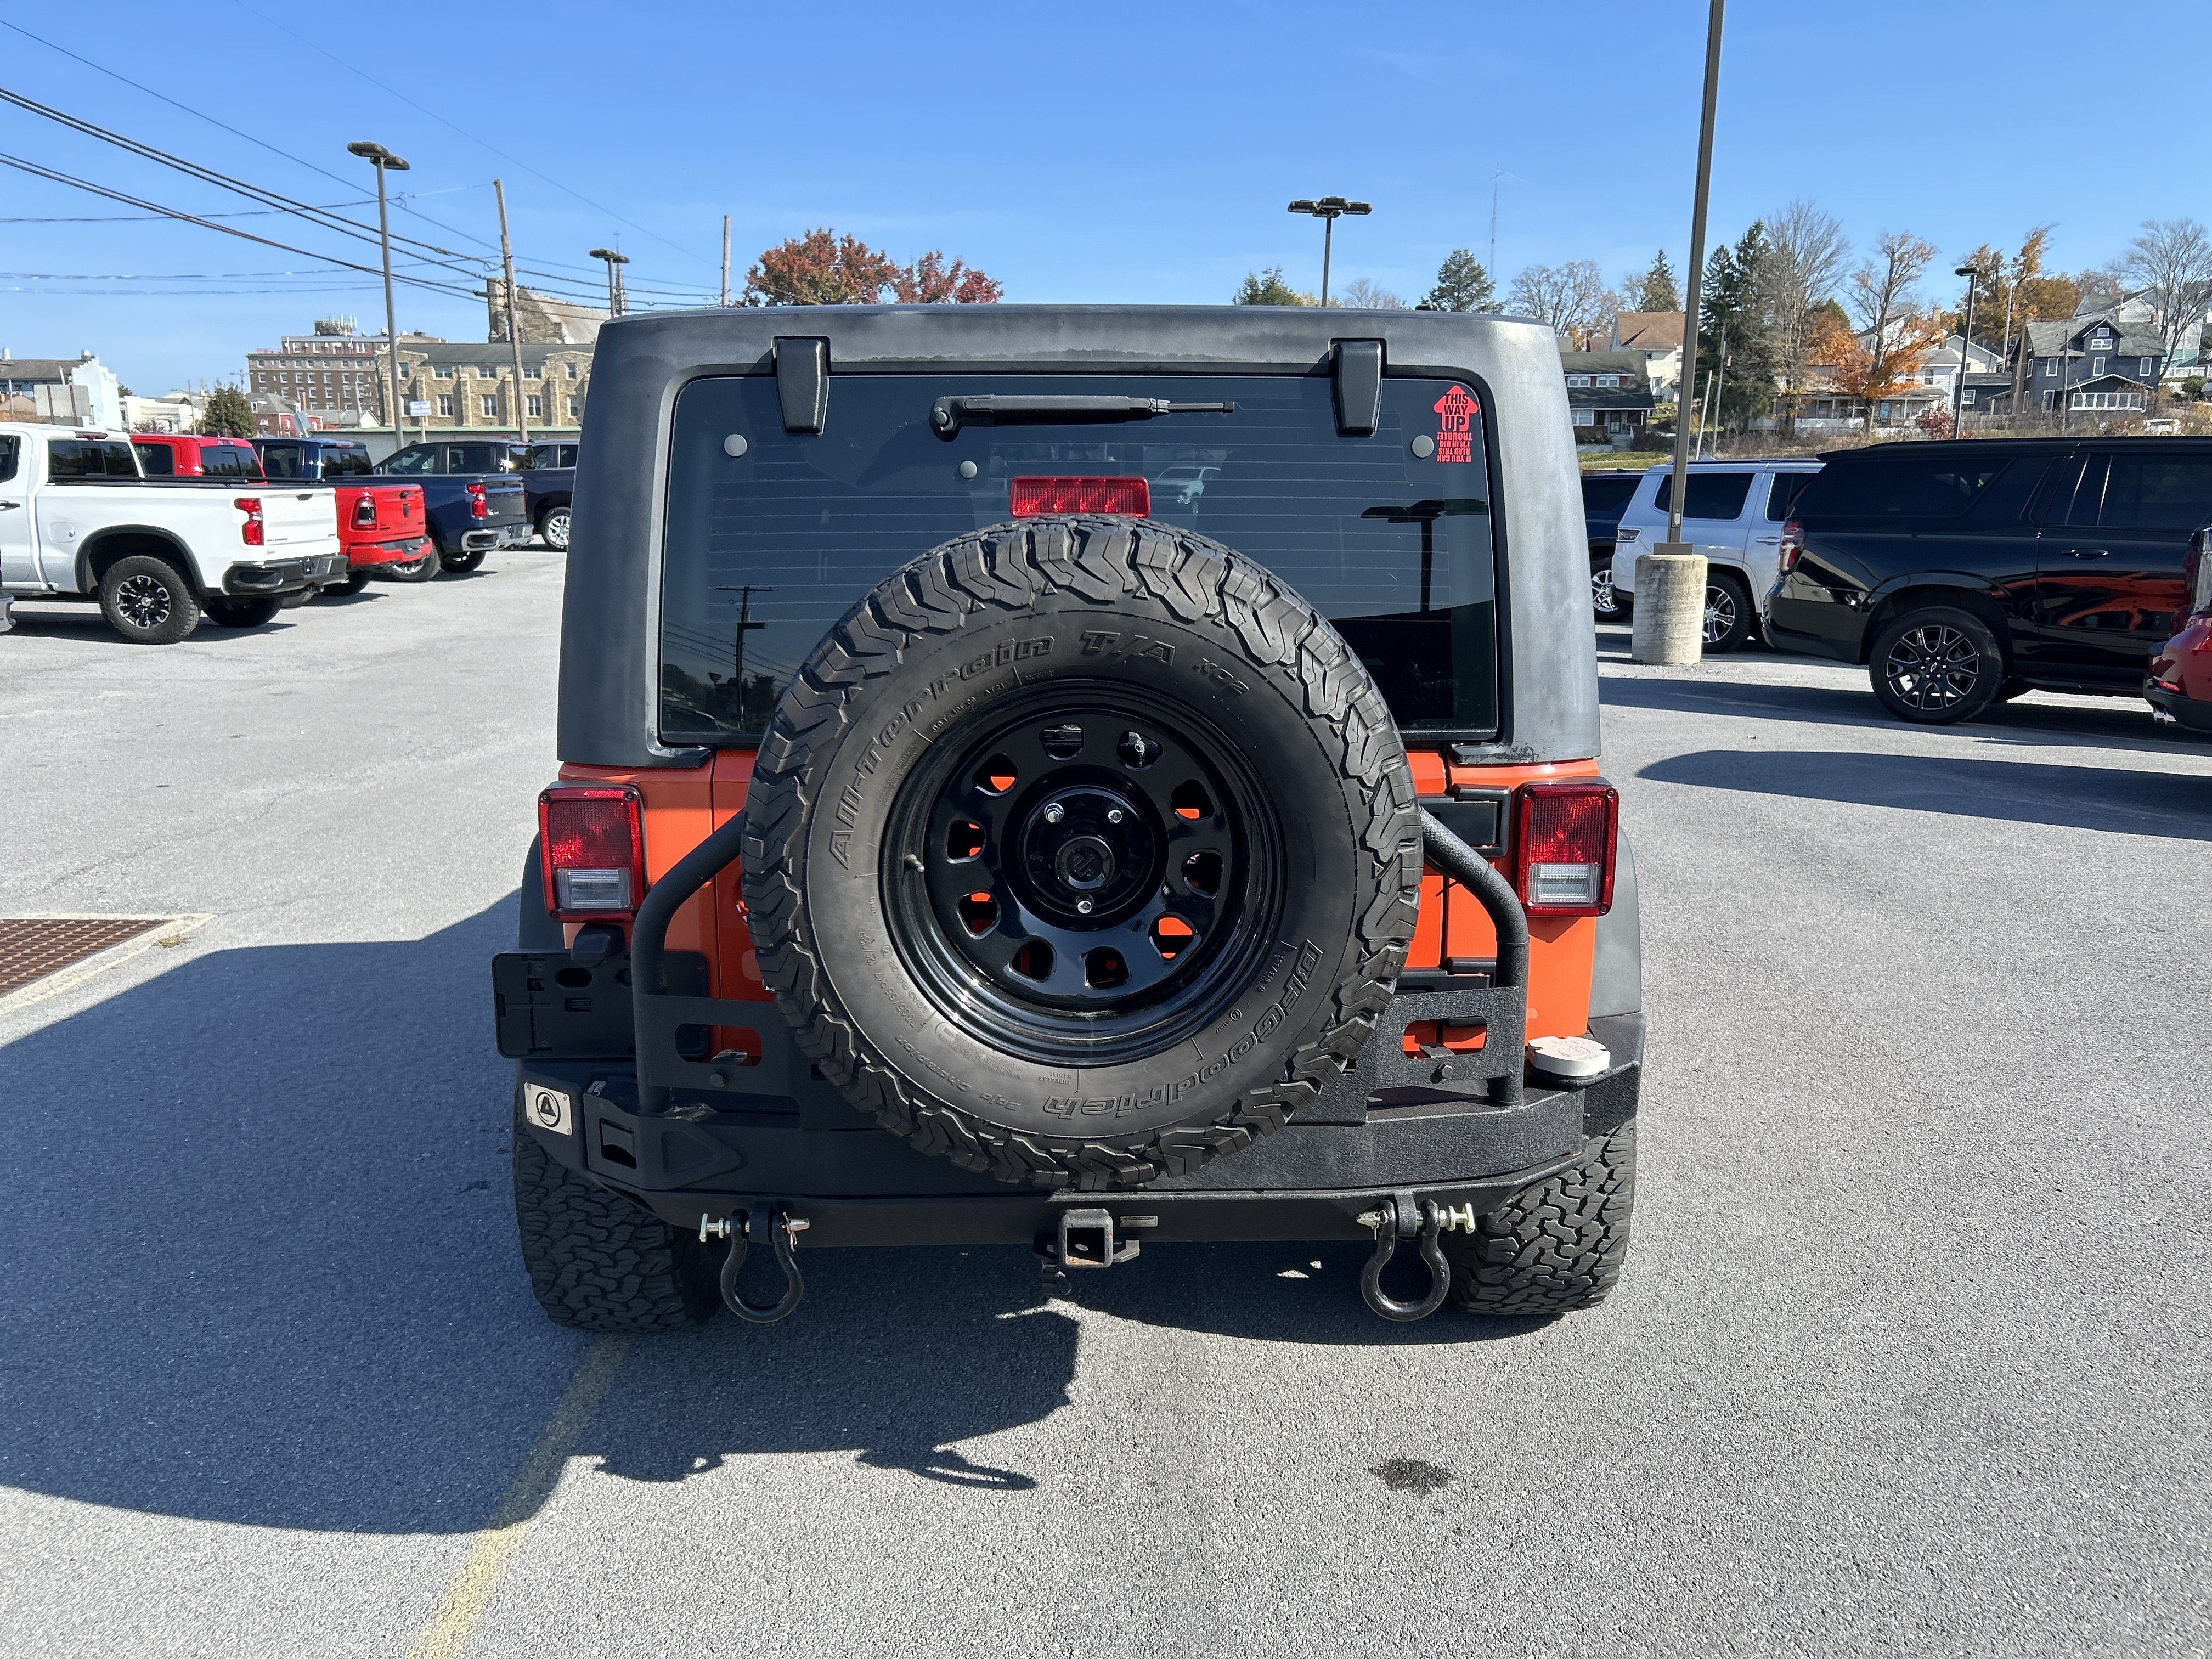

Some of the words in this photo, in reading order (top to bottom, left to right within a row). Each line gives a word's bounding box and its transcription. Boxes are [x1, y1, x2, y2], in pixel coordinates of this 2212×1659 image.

[1444, 405, 1468, 415] WAY
[1446, 394, 1468, 404] THIS
[1437, 432, 1472, 440] TROUBLE!
[1445, 416, 1466, 431] UP
[829, 635, 1055, 870] All-Terrain
[1080, 629, 1176, 667] T/A
[888, 958, 911, 991] RANGE
[908, 989, 928, 1014] LOAD
[1043, 939, 1323, 1120] BFGoodrich
[894, 1034, 973, 1092] Champion
